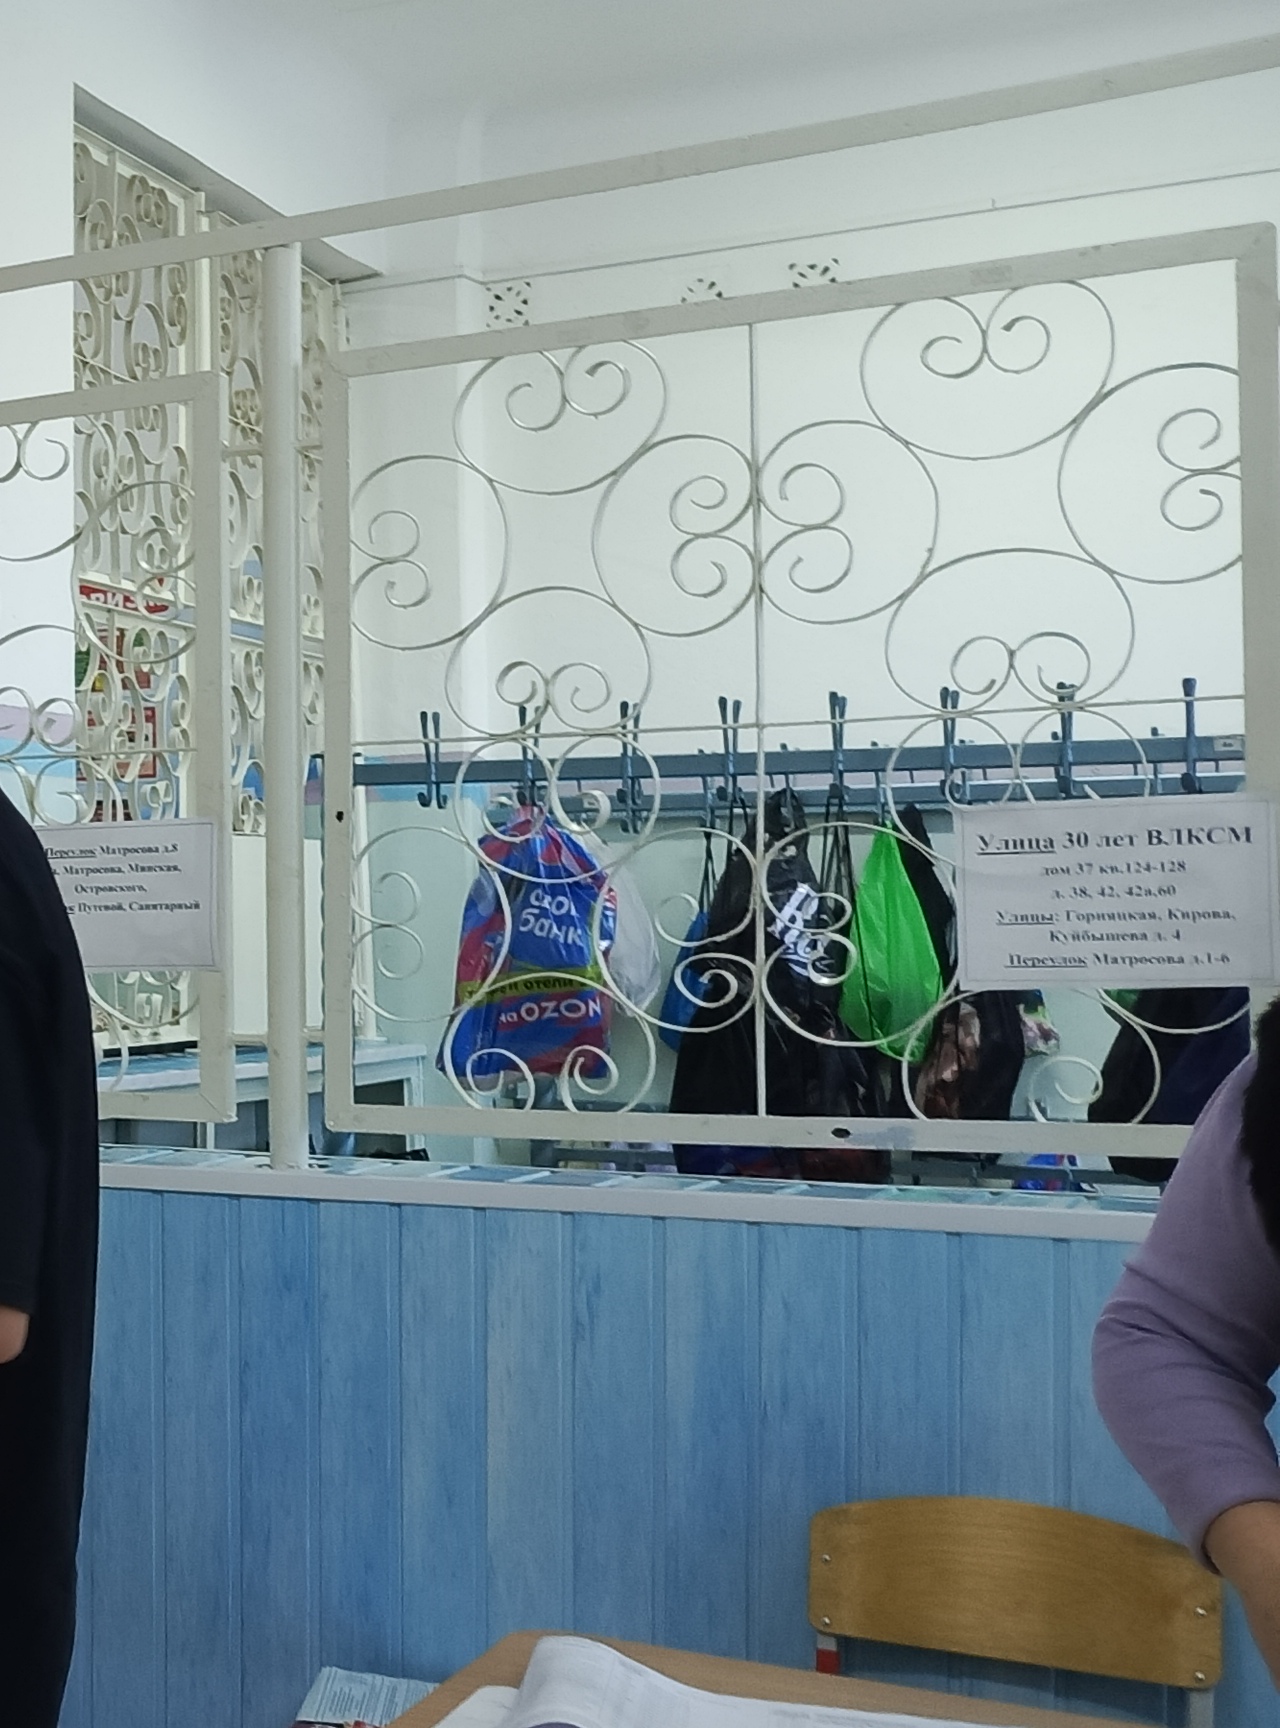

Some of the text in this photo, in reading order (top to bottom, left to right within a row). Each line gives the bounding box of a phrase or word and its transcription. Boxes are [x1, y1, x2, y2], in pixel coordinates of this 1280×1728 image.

[976, 826, 1252, 855] Улица 30 лет ВЛКСМ
[1075, 861, 1094, 875] 37
[996, 910, 1060, 926] Улицы:
[1049, 929, 1148, 945] Куйбышева
[1005, 953, 1088, 969] Переулок
[1092, 953, 1185, 968] Матросова
[520, 998, 602, 1022] OZON
